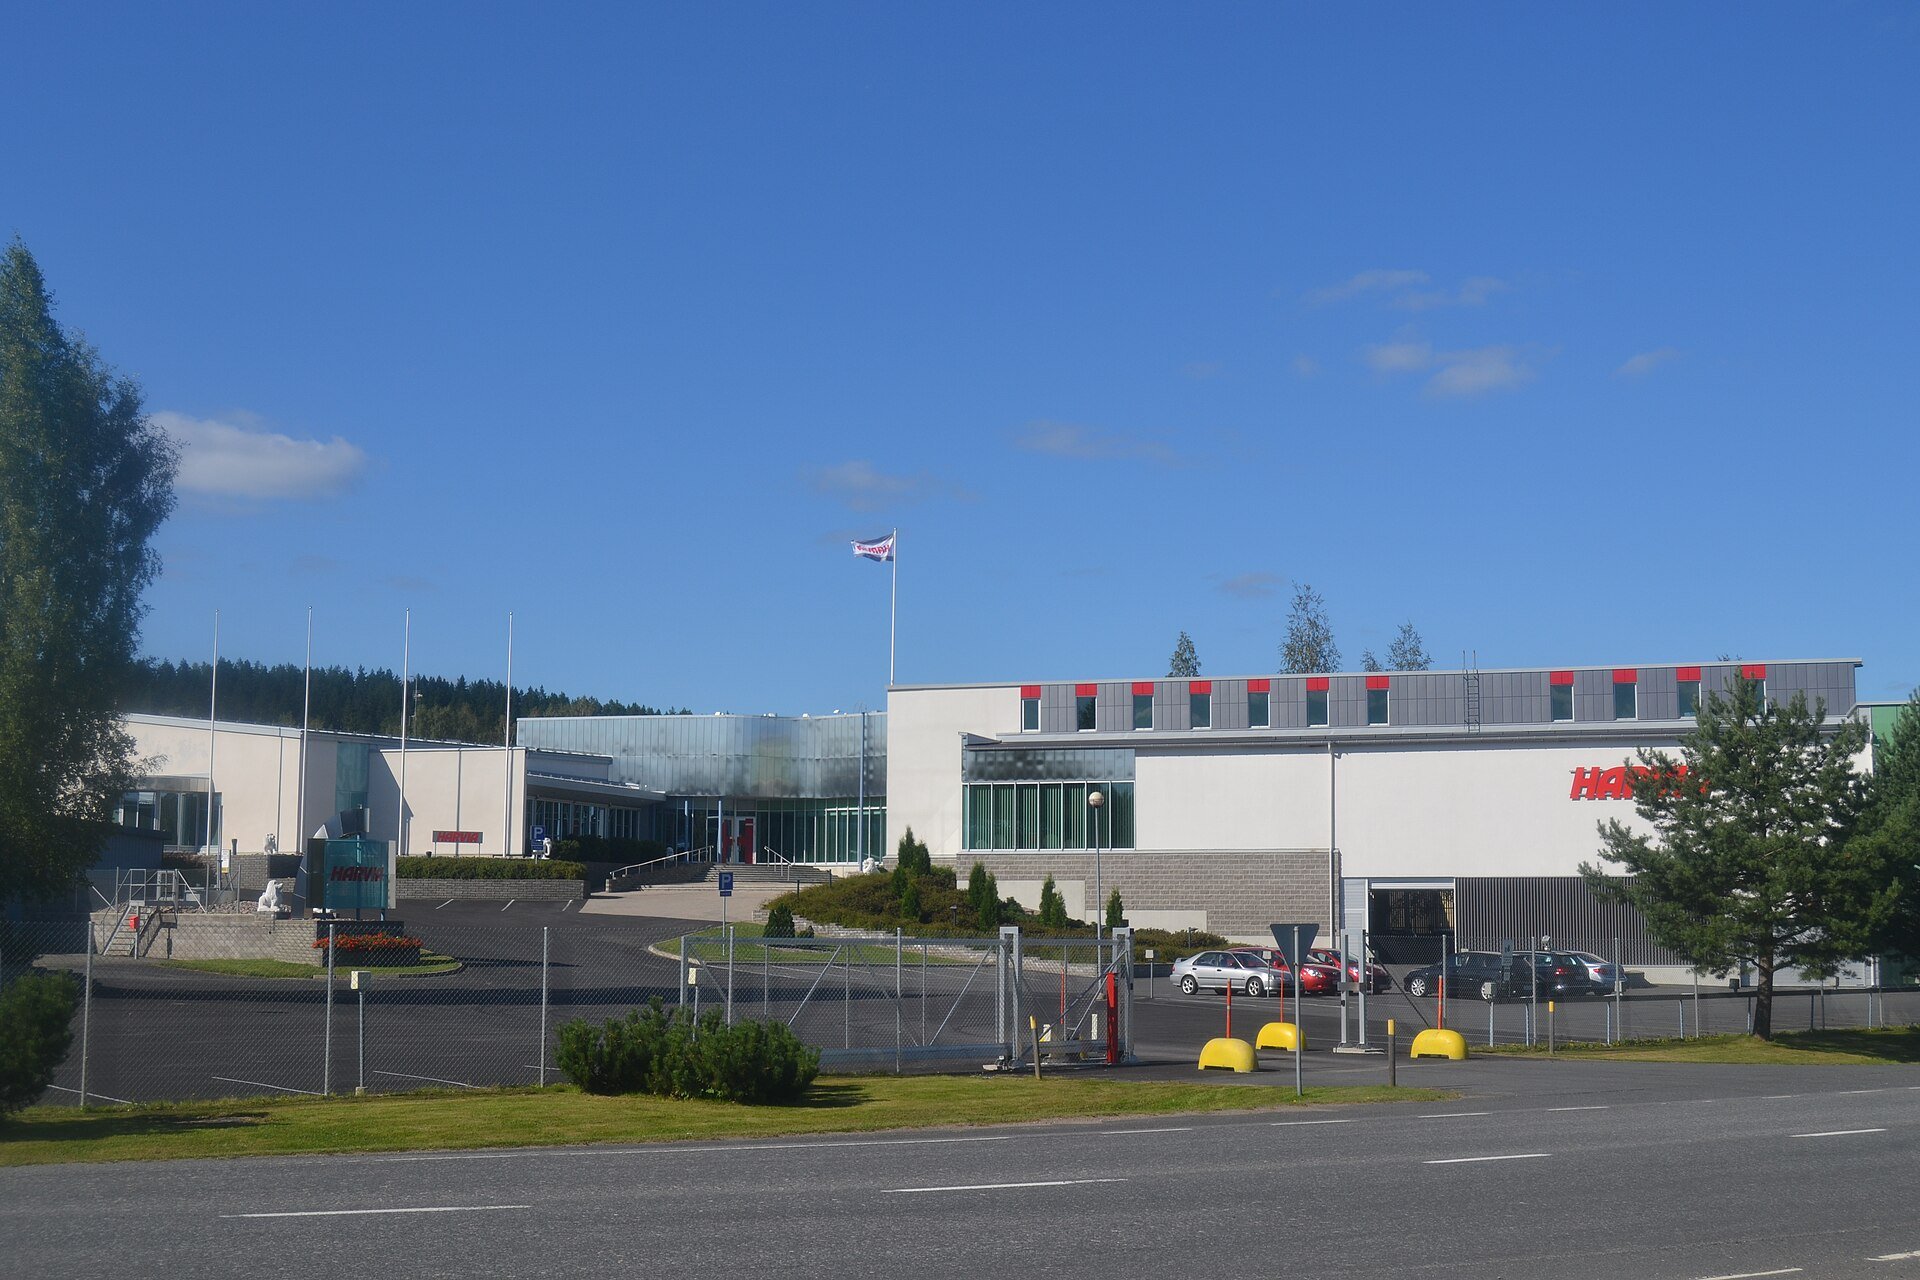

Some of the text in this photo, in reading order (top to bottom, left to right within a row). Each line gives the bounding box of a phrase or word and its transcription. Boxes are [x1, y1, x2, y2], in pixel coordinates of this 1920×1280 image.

[437, 831, 479, 843] HARVIA
[534, 827, 543, 839] P
[721, 874, 731, 889] P
